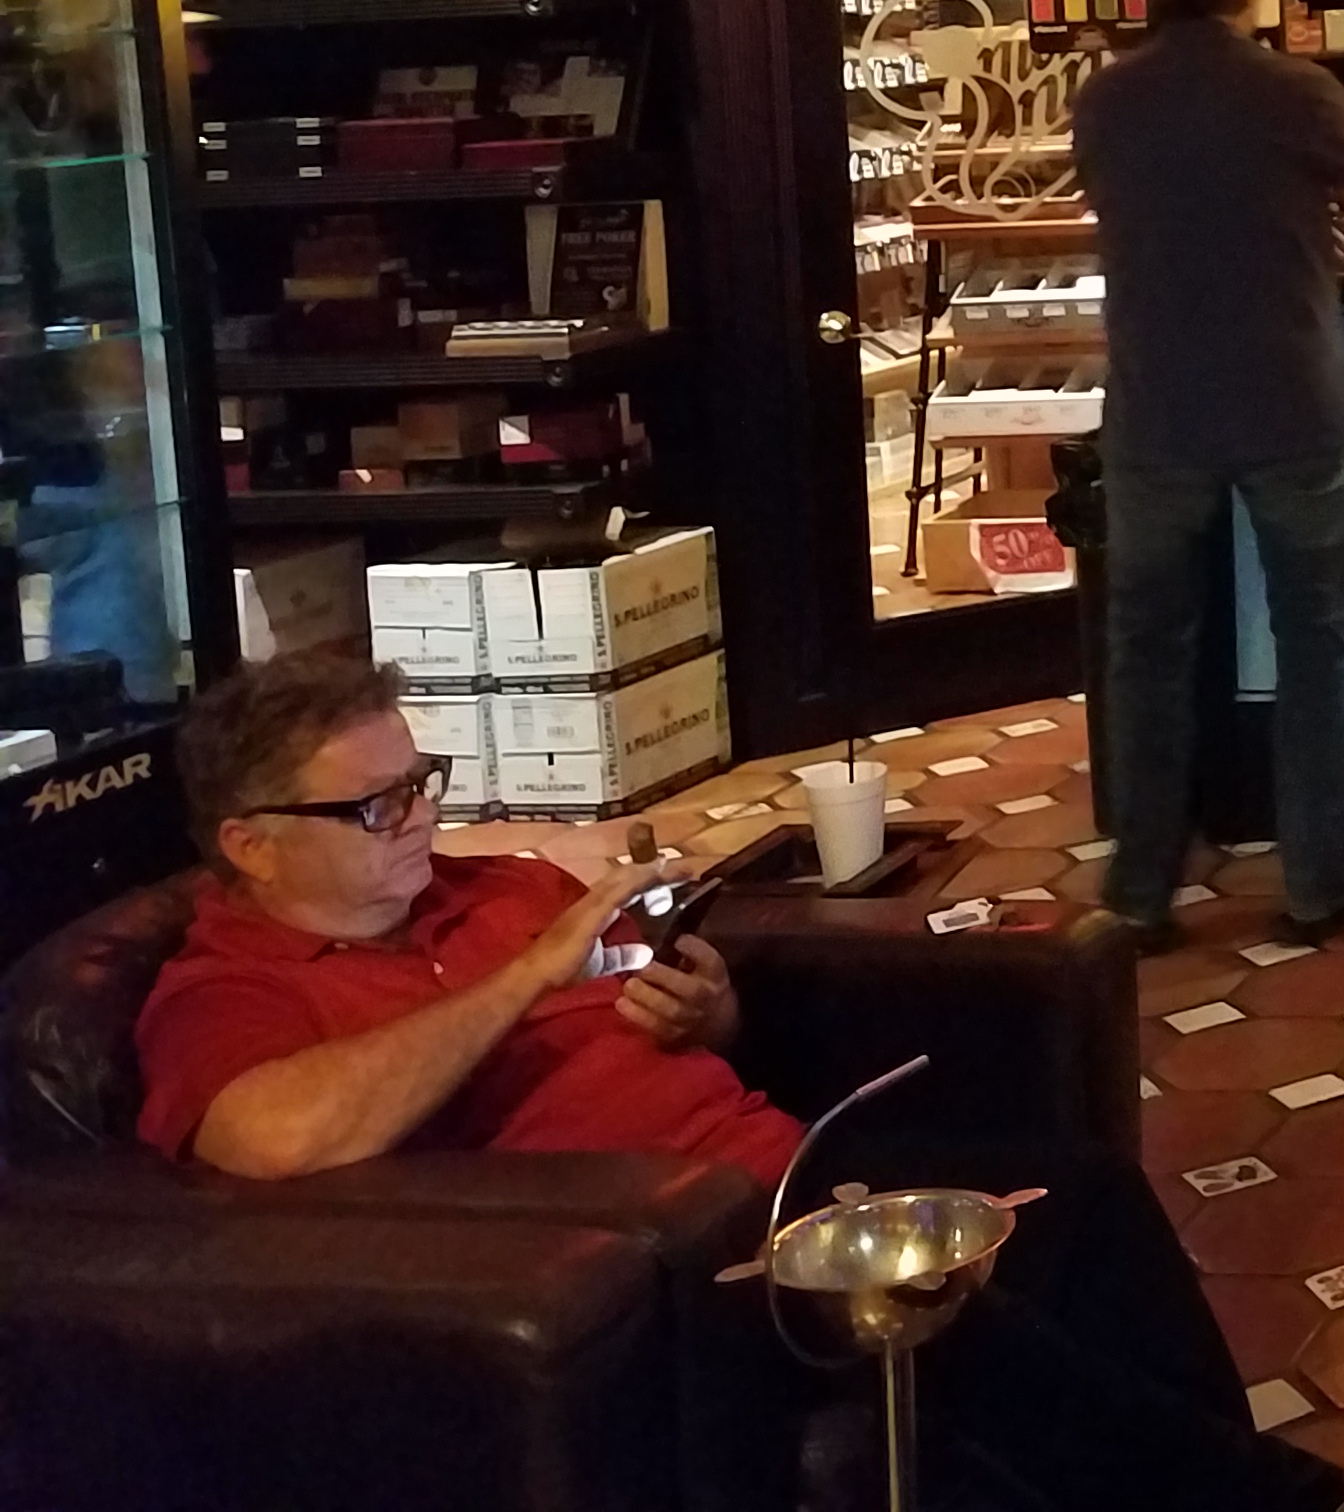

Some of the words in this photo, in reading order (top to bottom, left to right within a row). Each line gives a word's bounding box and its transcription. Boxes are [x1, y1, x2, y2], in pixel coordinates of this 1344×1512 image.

[561, 231, 592, 244] FREE
[595, 229, 636, 243] POKER
[396, 655, 460, 665] PELLEGRINO
